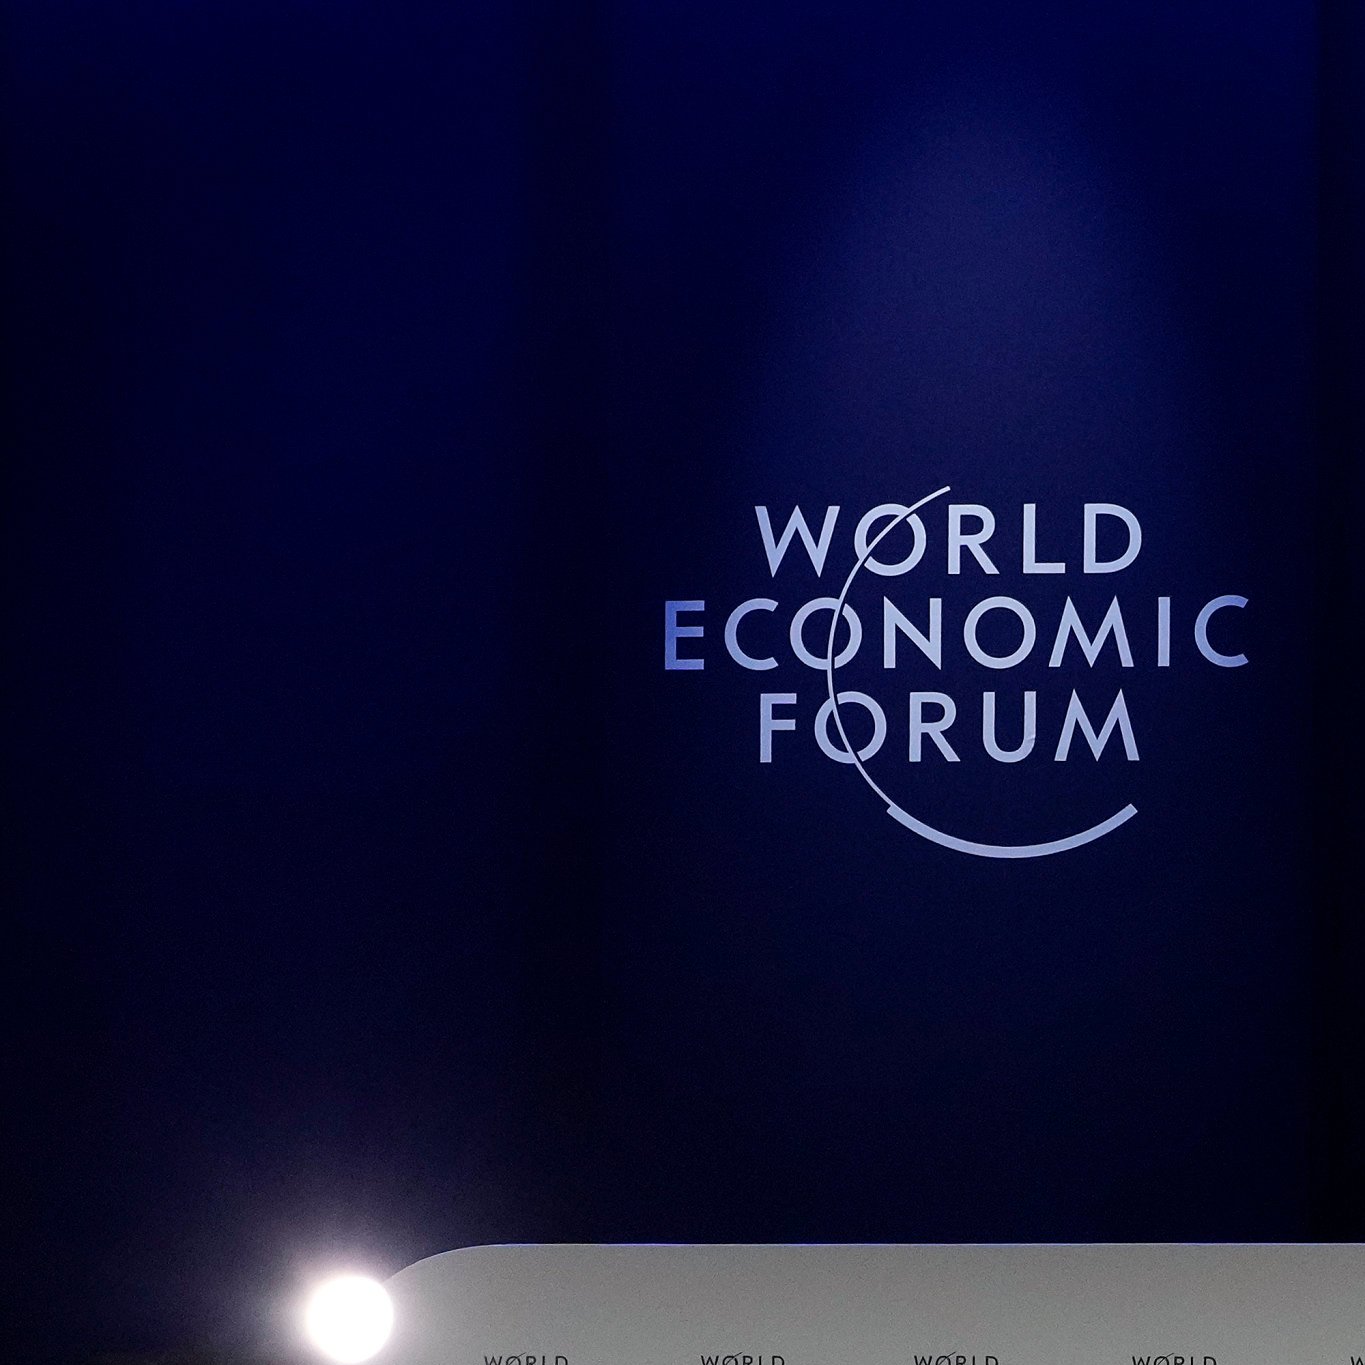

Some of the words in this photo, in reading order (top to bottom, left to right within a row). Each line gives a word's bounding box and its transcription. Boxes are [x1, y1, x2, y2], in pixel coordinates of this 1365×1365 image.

[755, 503, 1143, 577] WORLD
[664, 595, 1250, 671] ECONOMIC
[759, 689, 1140, 764] FORUM
